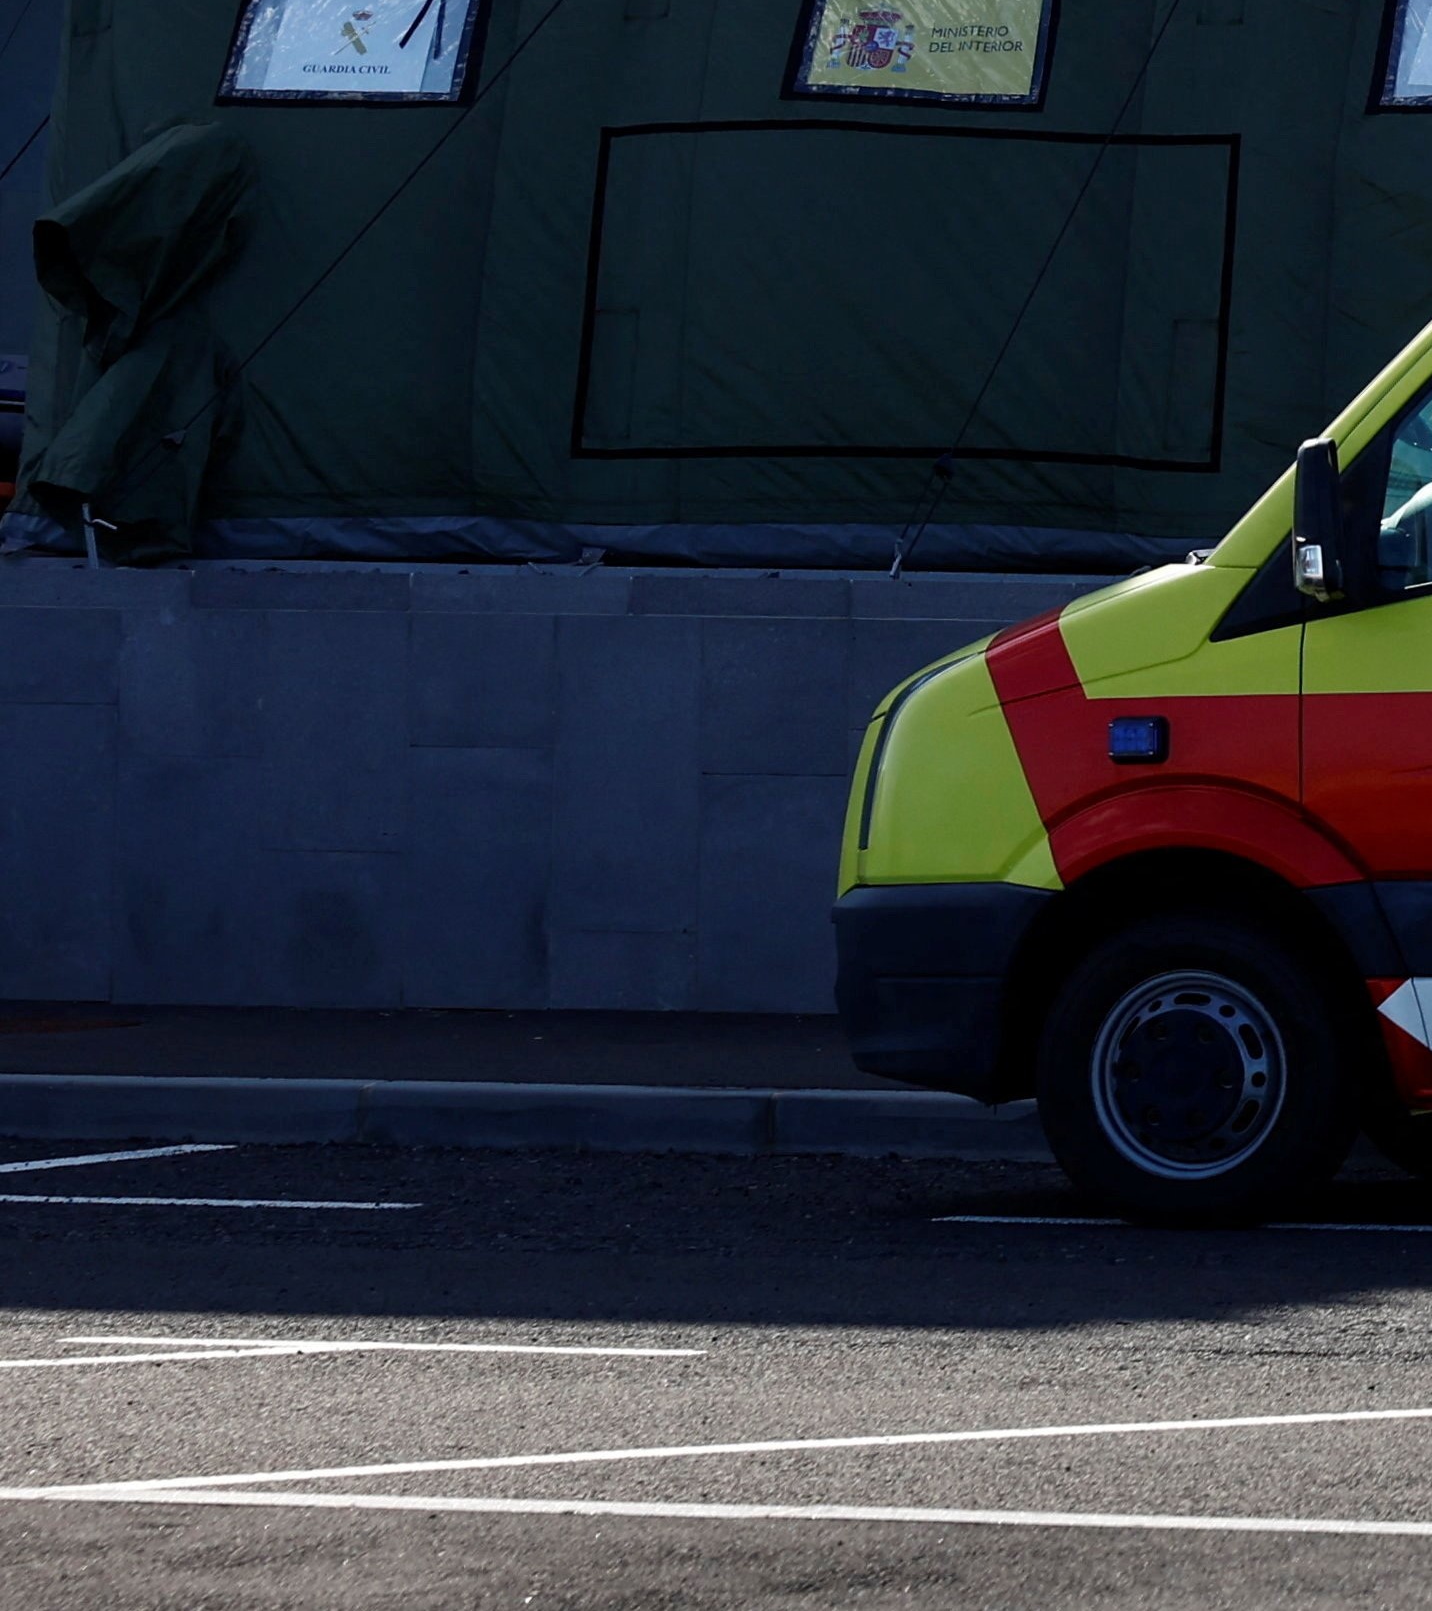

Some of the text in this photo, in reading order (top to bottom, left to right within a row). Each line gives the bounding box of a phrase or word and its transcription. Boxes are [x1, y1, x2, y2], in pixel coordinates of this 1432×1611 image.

[931, 25, 1008, 38] MINISTERIO
[929, 40, 1023, 54] DEL INTERIOR
[303, 64, 391, 74] GUARDIA CIVIL
